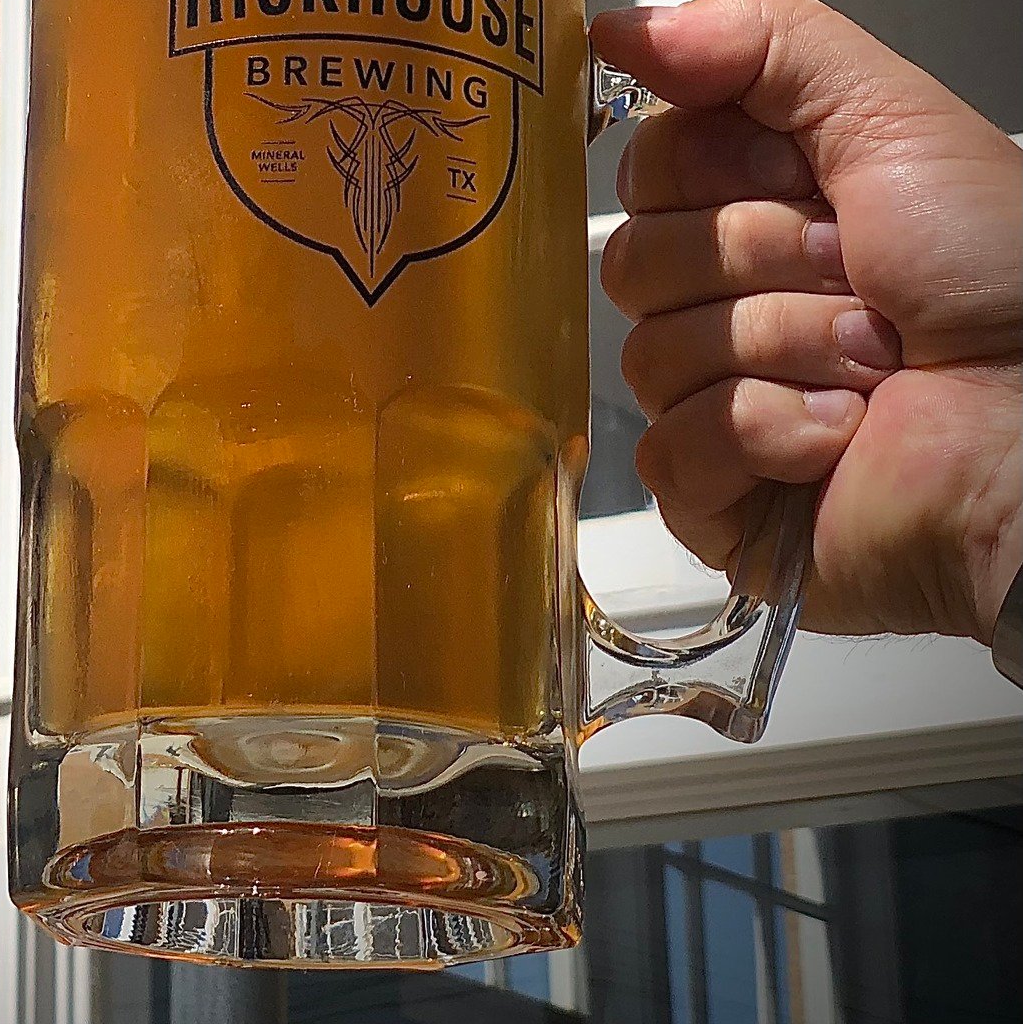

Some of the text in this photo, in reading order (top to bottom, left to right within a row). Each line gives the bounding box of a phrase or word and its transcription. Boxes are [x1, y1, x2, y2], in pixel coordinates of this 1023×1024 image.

[246, 55, 490, 110] BREWING
[250, 148, 305, 161] MINERAL
[257, 161, 298, 173] WELLS
[448, 166, 477, 193] TX
